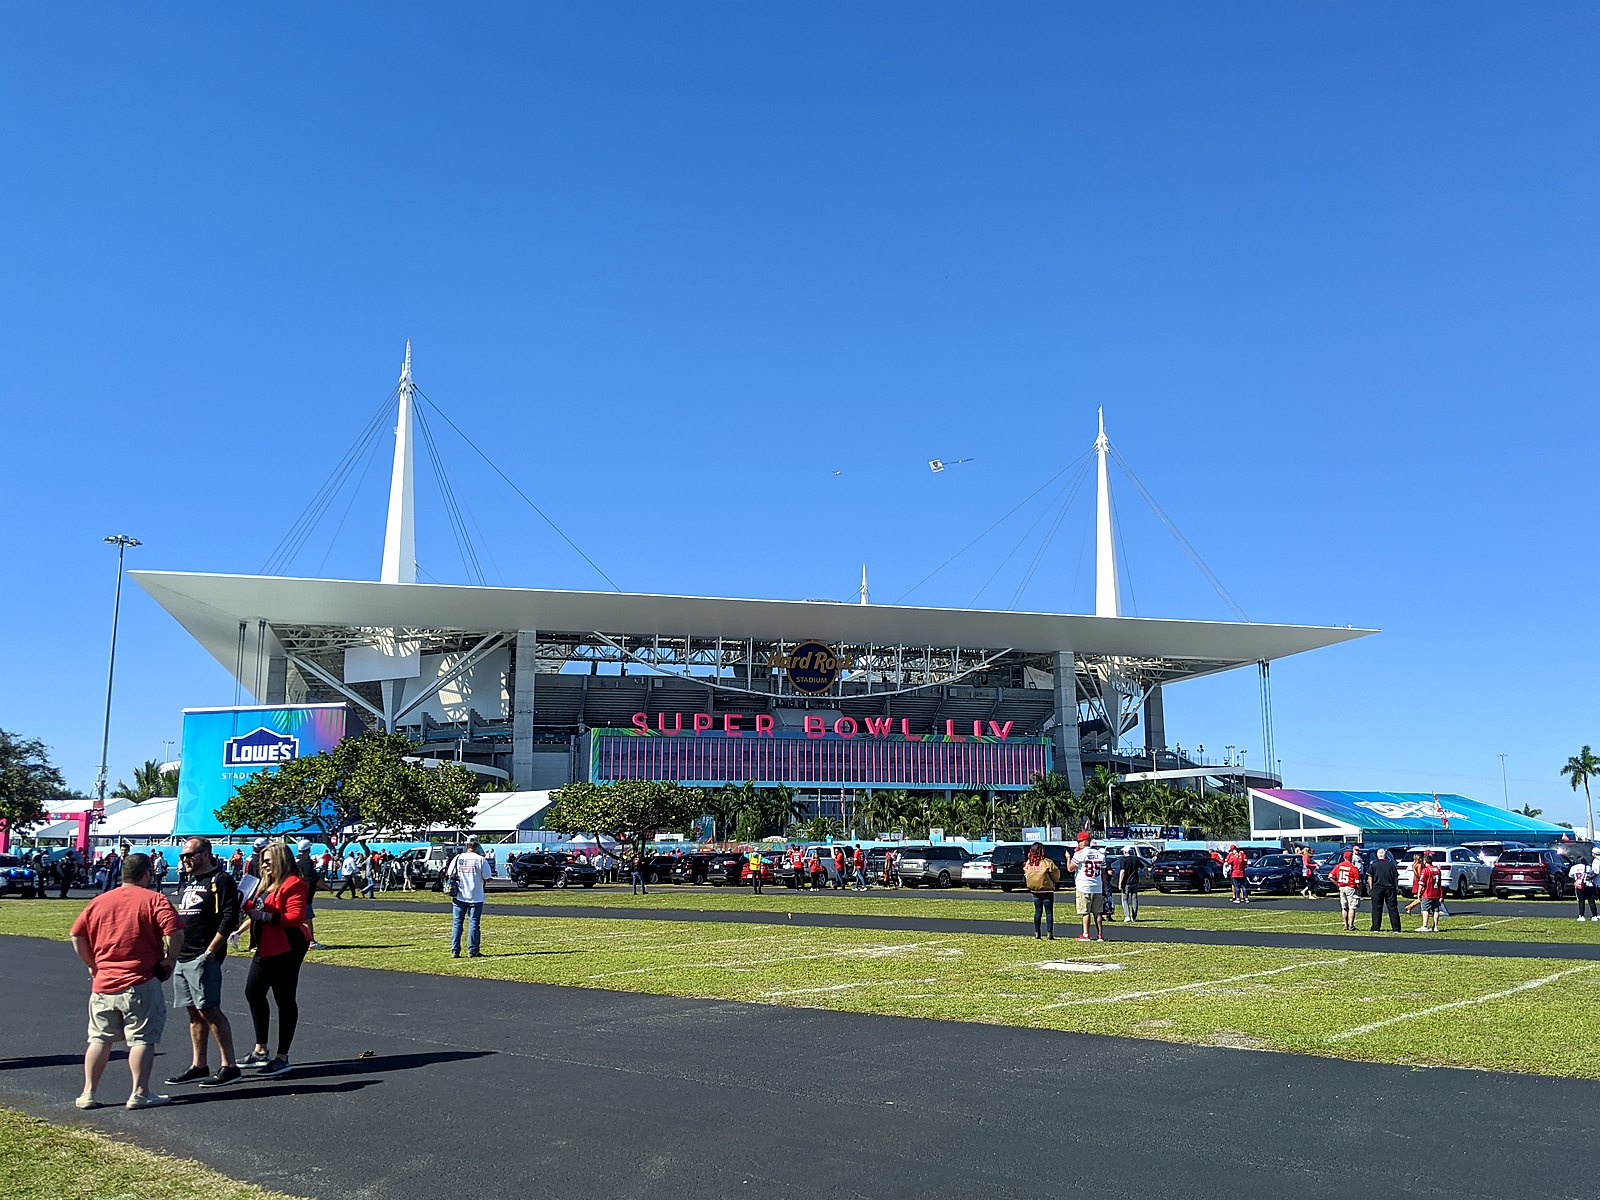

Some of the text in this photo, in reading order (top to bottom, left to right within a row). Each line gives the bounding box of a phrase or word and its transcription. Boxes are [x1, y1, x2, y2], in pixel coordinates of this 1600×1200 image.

[767, 651, 854, 674] Hard Rock
[796, 676, 828, 684] STADIUM
[632, 711, 1014, 741] SUPER BOWL LIV
[231, 741, 294, 762] LOWE'S
[1084, 861, 1102, 877] 85
[1338, 870, 1350, 884] 15
